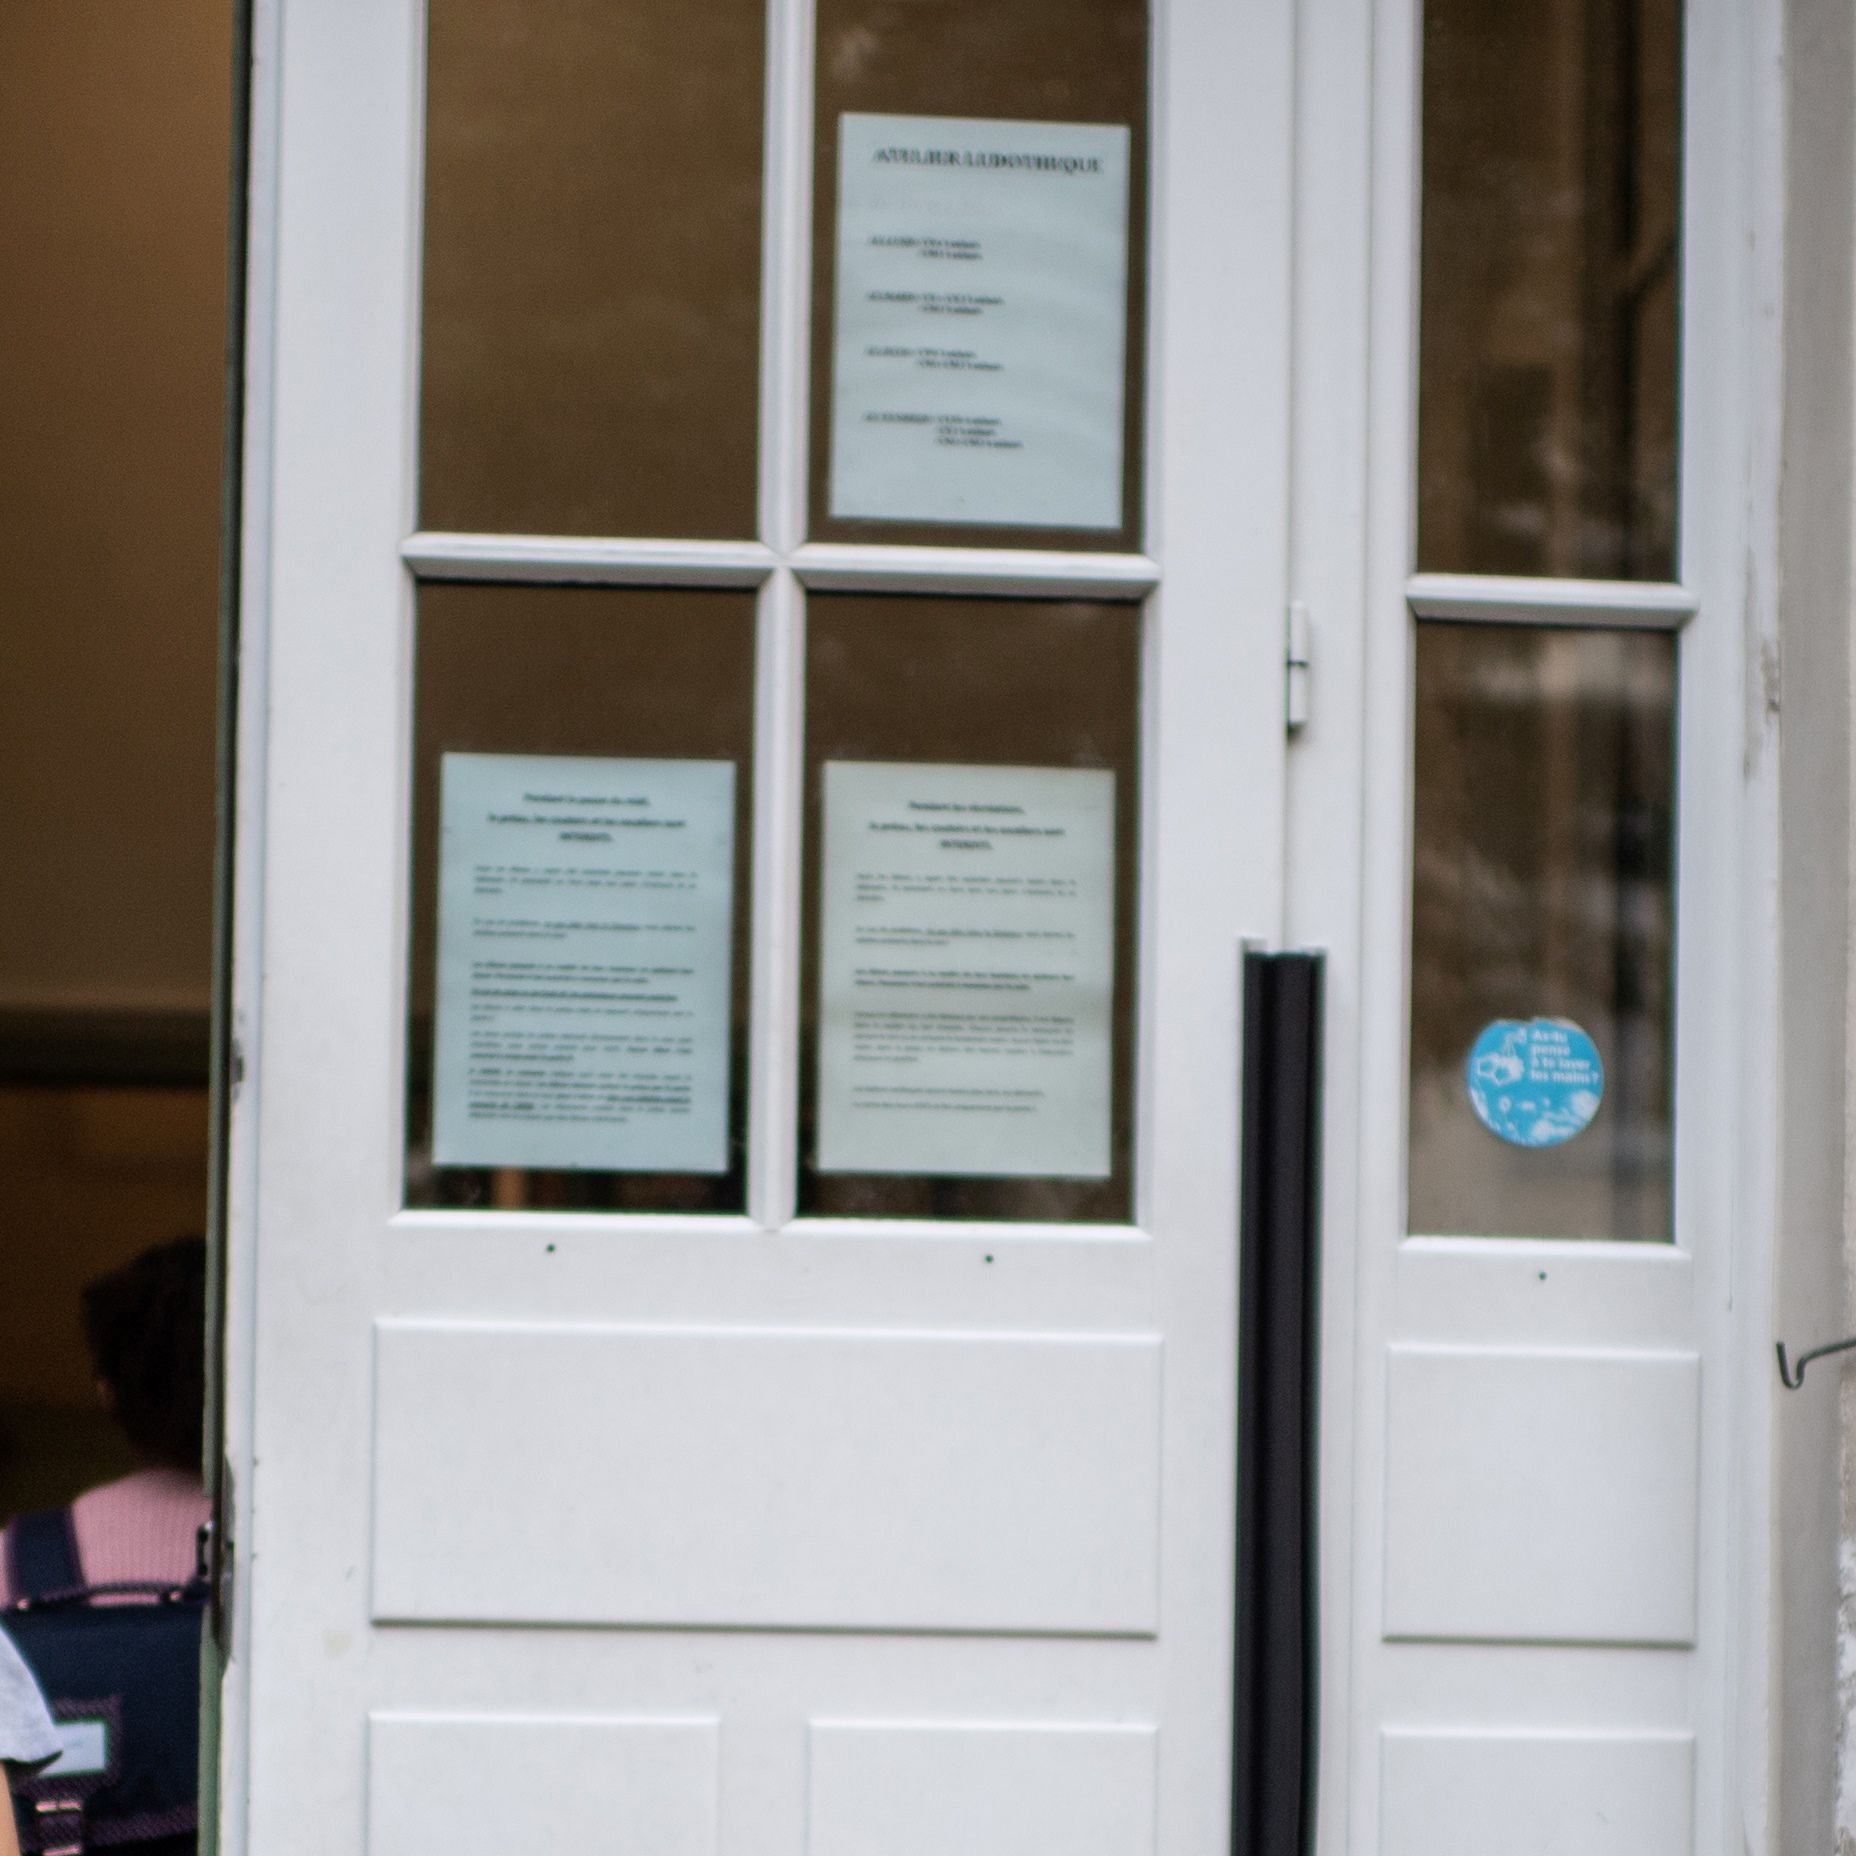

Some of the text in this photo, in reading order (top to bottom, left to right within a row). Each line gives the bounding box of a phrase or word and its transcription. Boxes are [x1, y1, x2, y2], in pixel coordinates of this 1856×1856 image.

[1533, 1030, 1568, 1042] As-tu
[1544, 1058, 1555, 1067] te
[1560, 1057, 1590, 1069] laver
[1531, 1070, 1549, 1081] les
[1553, 1071, 1590, 1083] mains
